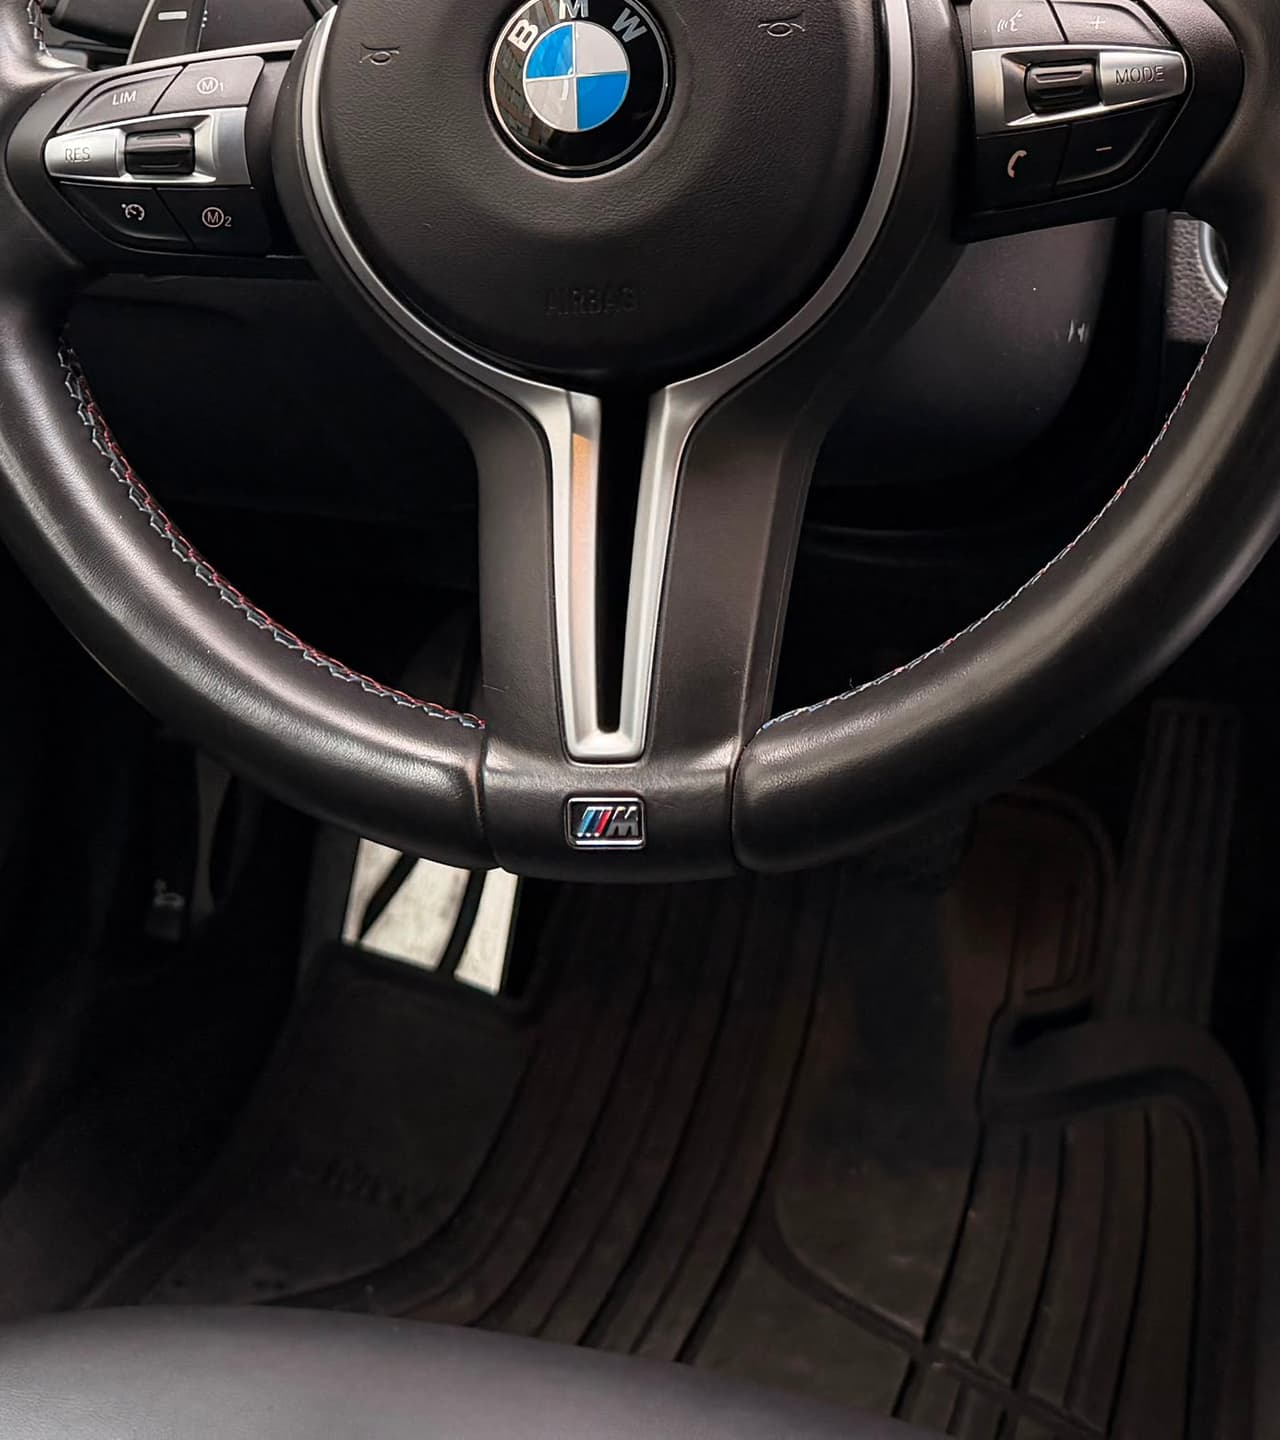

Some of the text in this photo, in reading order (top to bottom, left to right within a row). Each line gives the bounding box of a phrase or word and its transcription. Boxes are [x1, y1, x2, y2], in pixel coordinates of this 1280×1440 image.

[1114, 65, 1165, 86] MODE
[111, 90, 137, 106] LIM
[64, 148, 91, 162] RES
